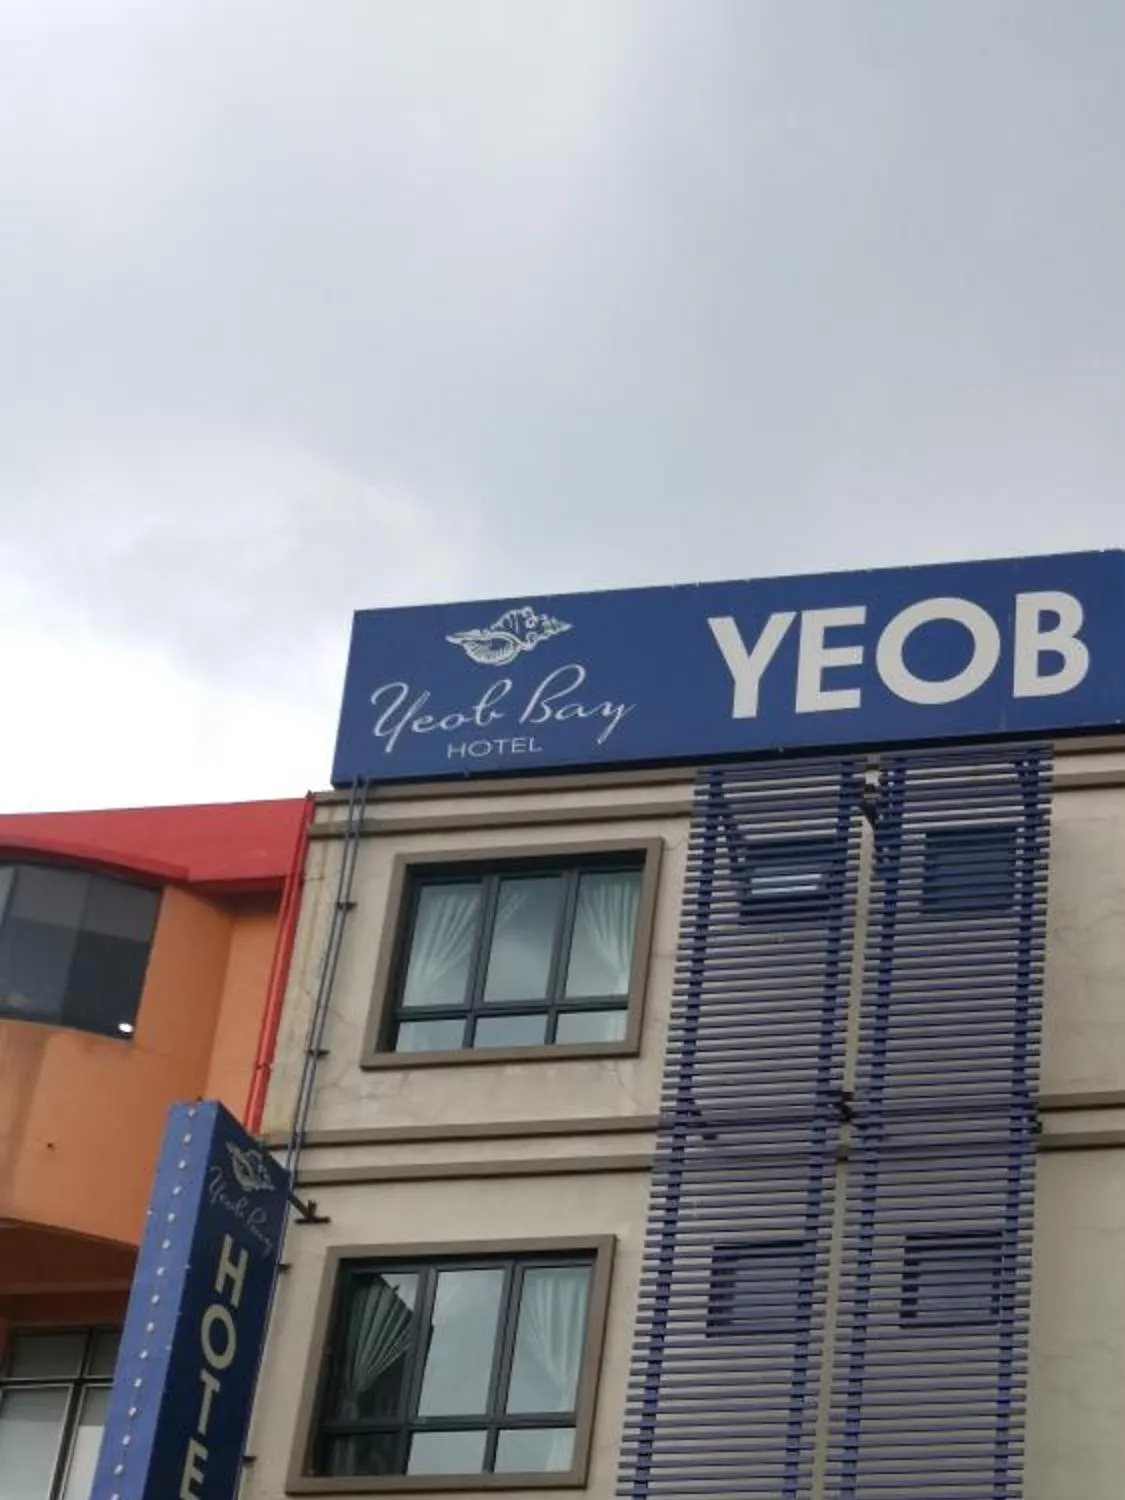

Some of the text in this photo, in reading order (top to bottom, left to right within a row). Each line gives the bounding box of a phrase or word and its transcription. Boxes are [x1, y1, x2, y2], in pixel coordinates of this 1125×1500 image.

[706, 591, 1091, 720] YEOB
[371, 664, 637, 753] Yeob Bay
[447, 737, 543, 759] HOTEL
